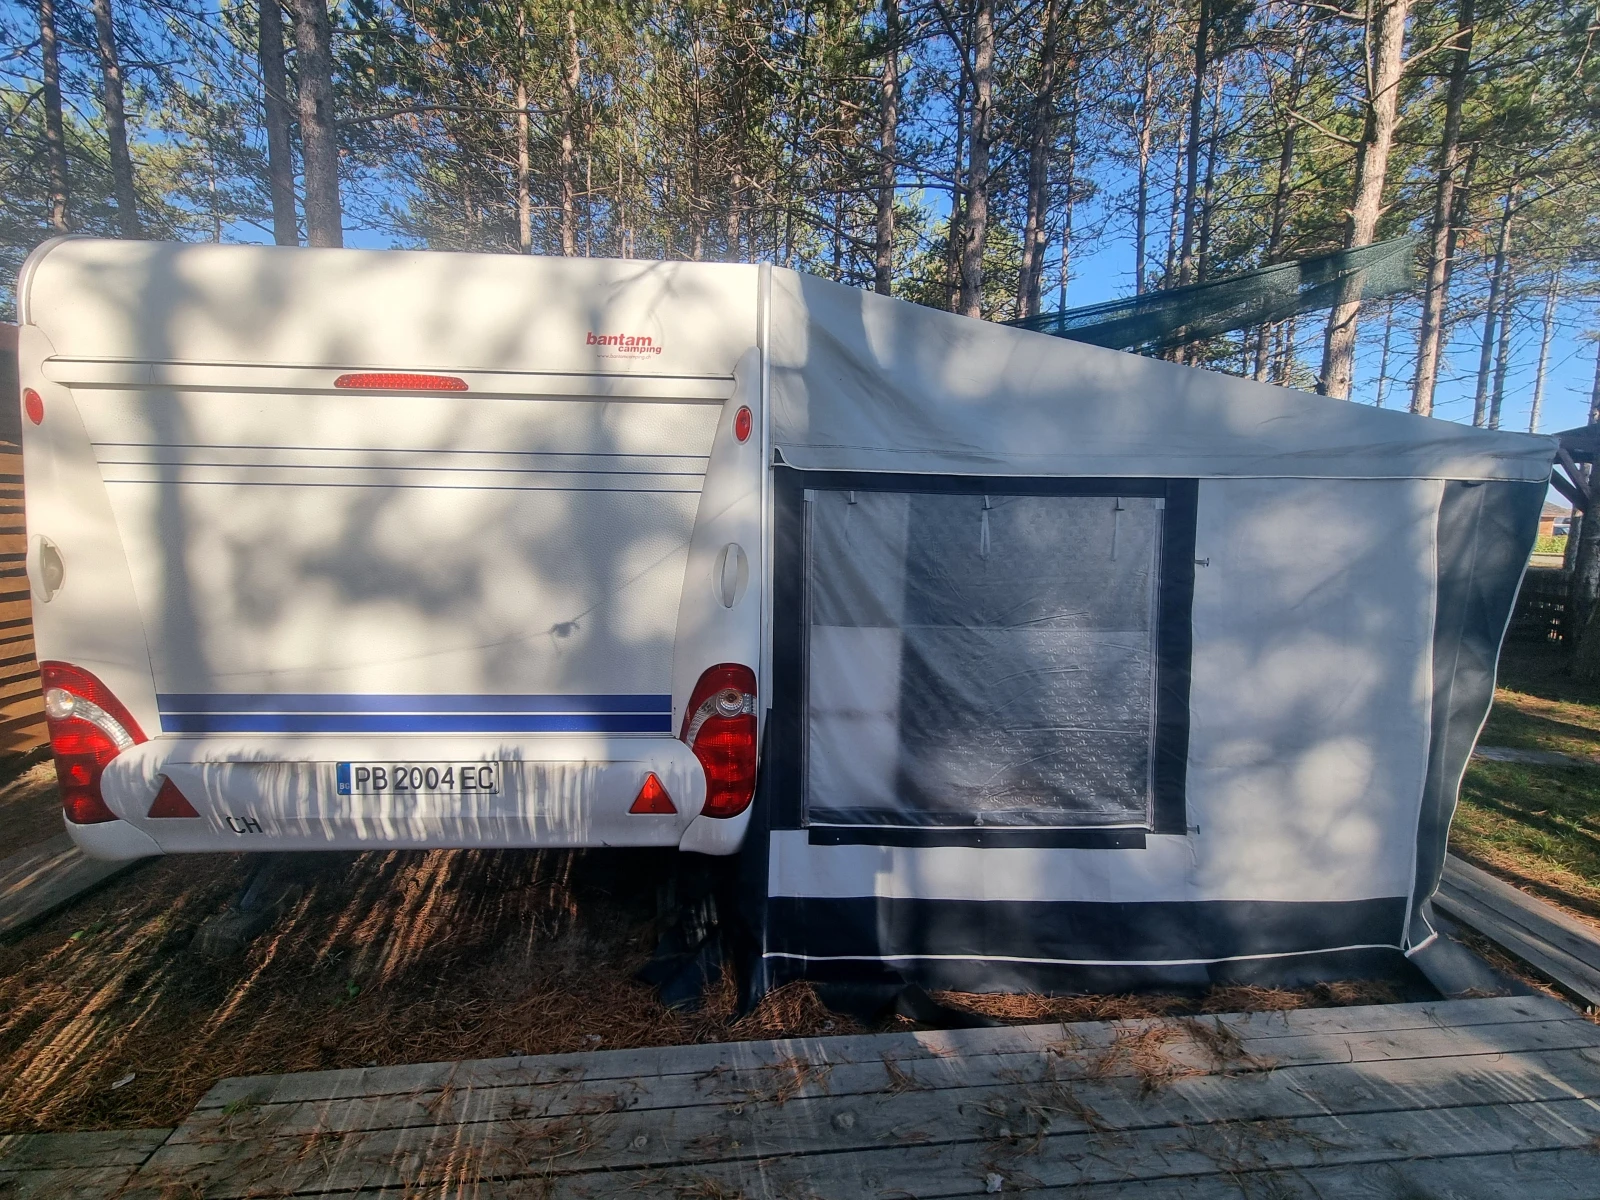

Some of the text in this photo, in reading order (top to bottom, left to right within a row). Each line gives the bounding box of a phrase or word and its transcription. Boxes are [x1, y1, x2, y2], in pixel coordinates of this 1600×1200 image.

[586, 332, 652, 346] bantam
[618, 346, 662, 355] camping
[355, 766, 494, 790] PB 2004 EC
[339, 782, 350, 790] BG
[226, 816, 264, 834] CH
